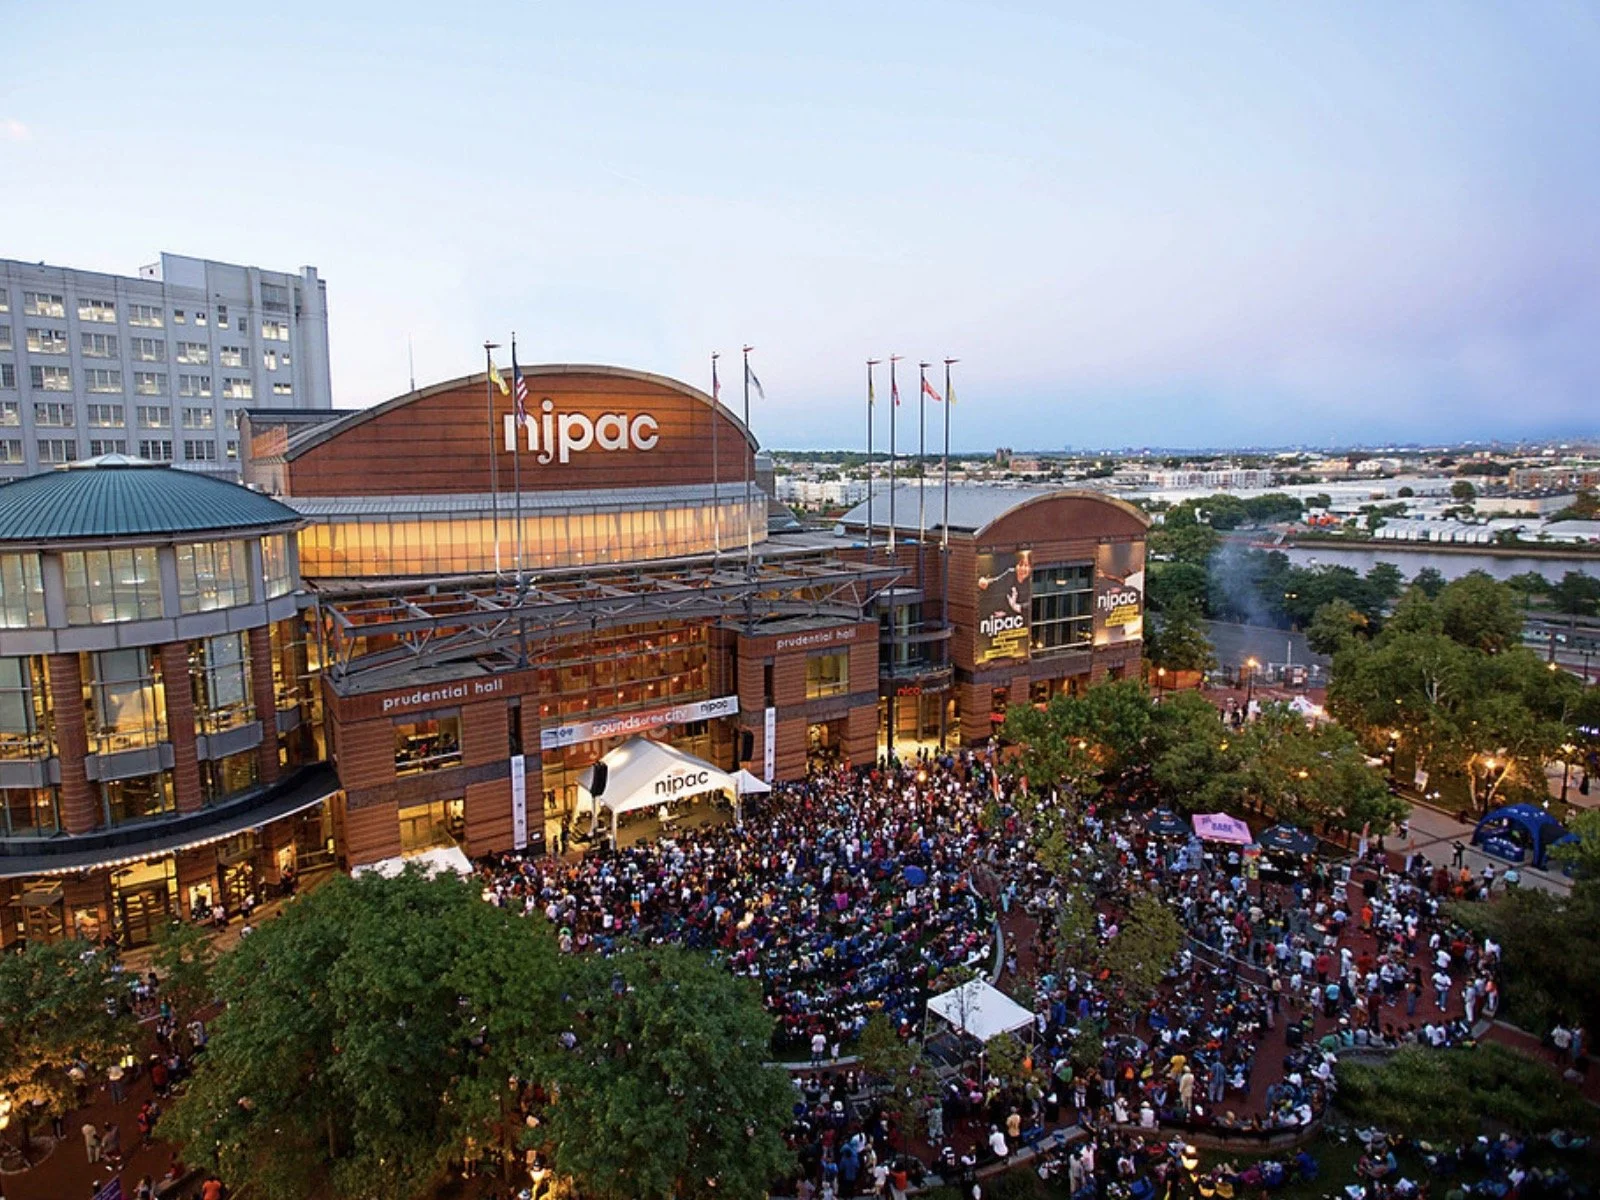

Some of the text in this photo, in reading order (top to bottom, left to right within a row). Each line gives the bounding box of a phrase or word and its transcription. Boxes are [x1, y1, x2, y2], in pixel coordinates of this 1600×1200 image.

[503, 399, 660, 465] njpac
[1097, 590, 1137, 612] njpac
[980, 614, 1024, 637] njpac
[776, 627, 857, 651] prudential hall
[383, 678, 503, 711] prudential hall
[592, 715, 641, 736] sounds
